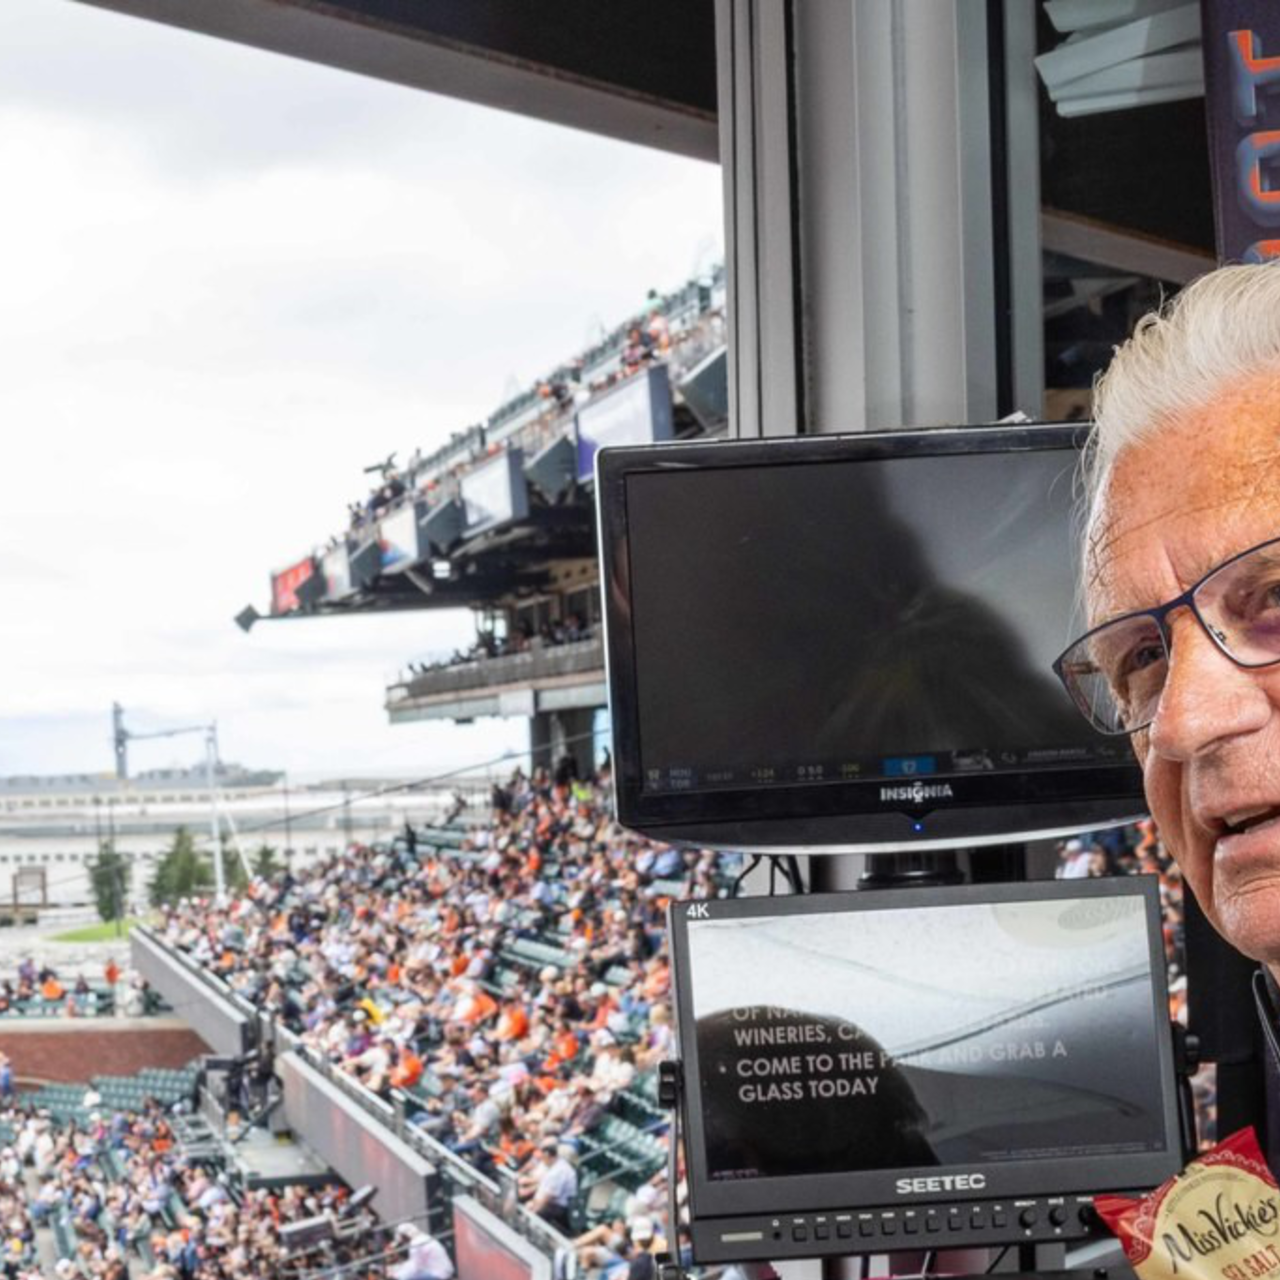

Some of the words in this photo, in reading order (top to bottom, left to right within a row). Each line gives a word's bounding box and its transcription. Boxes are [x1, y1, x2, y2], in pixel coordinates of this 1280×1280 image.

[880, 782, 953, 803] INSIGNIA
[686, 902, 710, 919] 4K
[733, 1023, 833, 1047] WINERIES,
[736, 1055, 802, 1078] COME
[805, 1053, 834, 1075] TO
[837, 1051, 874, 1072] THE
[938, 1045, 983, 1064] AND
[988, 1041, 1046, 1062] GRAB
[1051, 1040, 1068, 1058] A
[738, 1082, 804, 1103] GLASS
[808, 1076, 880, 1098] TODAY
[895, 1173, 987, 1195] SEETEC
[1162, 1222, 1220, 1274] Miss
[1198, 1192, 1280, 1246] Vickie's
